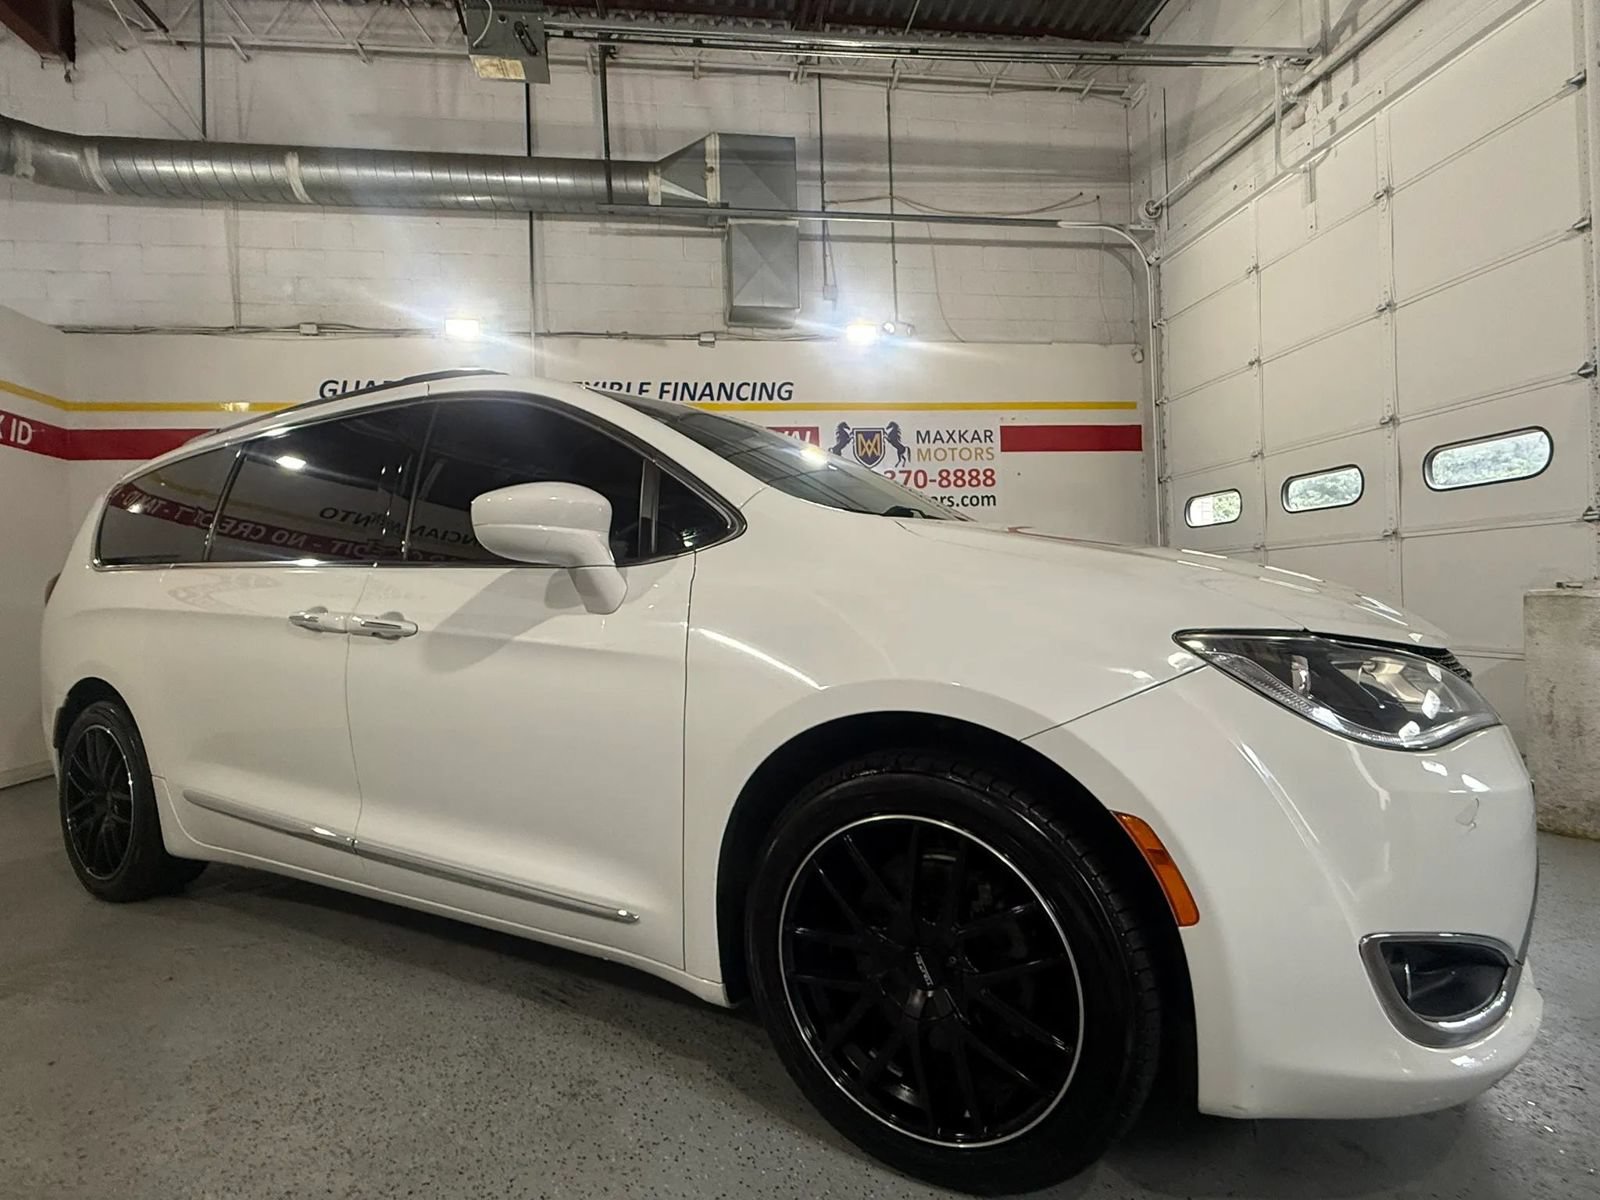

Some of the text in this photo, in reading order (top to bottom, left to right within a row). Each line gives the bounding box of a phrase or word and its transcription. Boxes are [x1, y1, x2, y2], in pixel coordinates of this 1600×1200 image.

[658, 381, 794, 401] FINANCING
[10, 417, 33, 445] ID
[916, 429, 994, 445] MAXKAR
[917, 446, 995, 462] MOTORS
